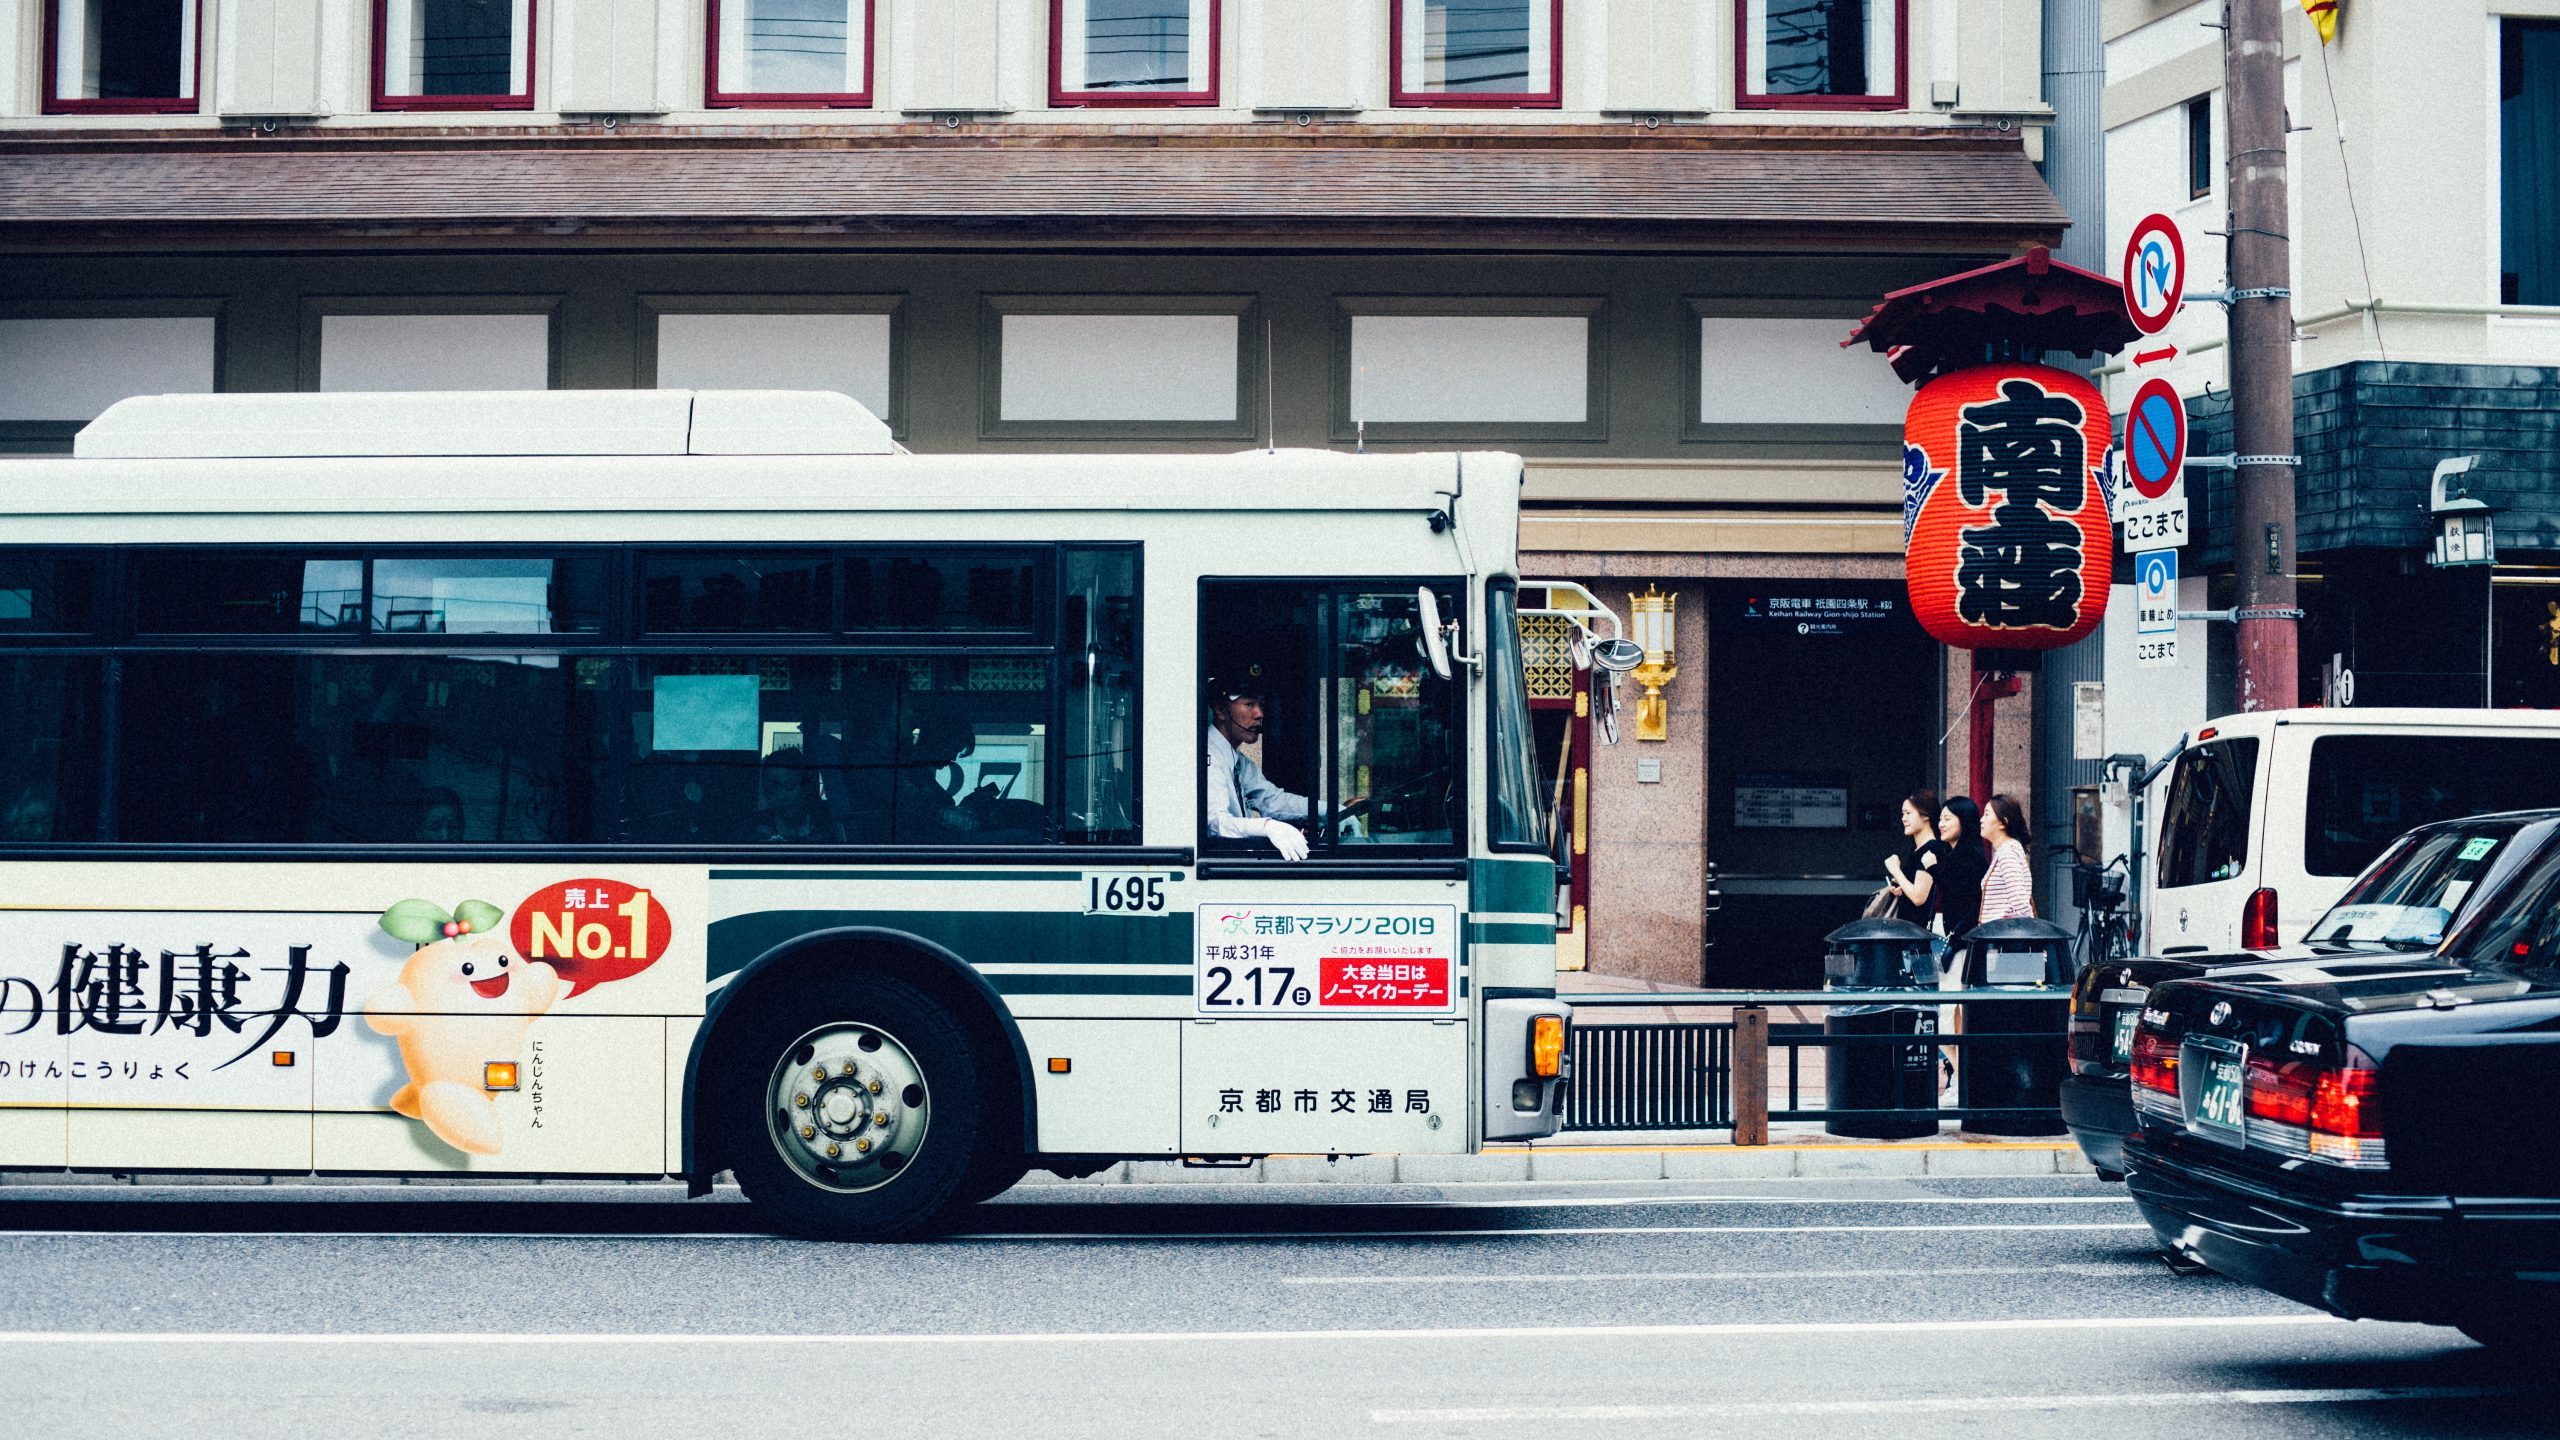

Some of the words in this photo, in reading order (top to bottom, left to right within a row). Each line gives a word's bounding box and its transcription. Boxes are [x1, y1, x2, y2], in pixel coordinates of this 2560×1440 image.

[2127, 509, 2184, 539] ここまで
[1769, 598, 1811, 609] 京阪電車
[1794, 610, 1822, 618] Railway
[2140, 608, 2174, 622] 車輪止め
[2139, 642, 2175, 660] ここまで
[564, 887, 610, 909] 売上
[1091, 876, 1165, 911] 1695
[531, 891, 649, 960] No.1
[1254, 915, 1435, 936] 京都マラソン2019
[1206, 945, 1275, 960] 平成31年
[1331, 946, 1433, 955] ご協力をお願いいたします
[1342, 963, 1427, 981] 大会当日は
[1324, 982, 1444, 1000] ノーマイカーデー
[0, 1060, 189, 1080] のけんこうりょく
[531, 1041, 543, 1128] にんじんちゃん
[1219, 1088, 1430, 1114] 京都市交通局
